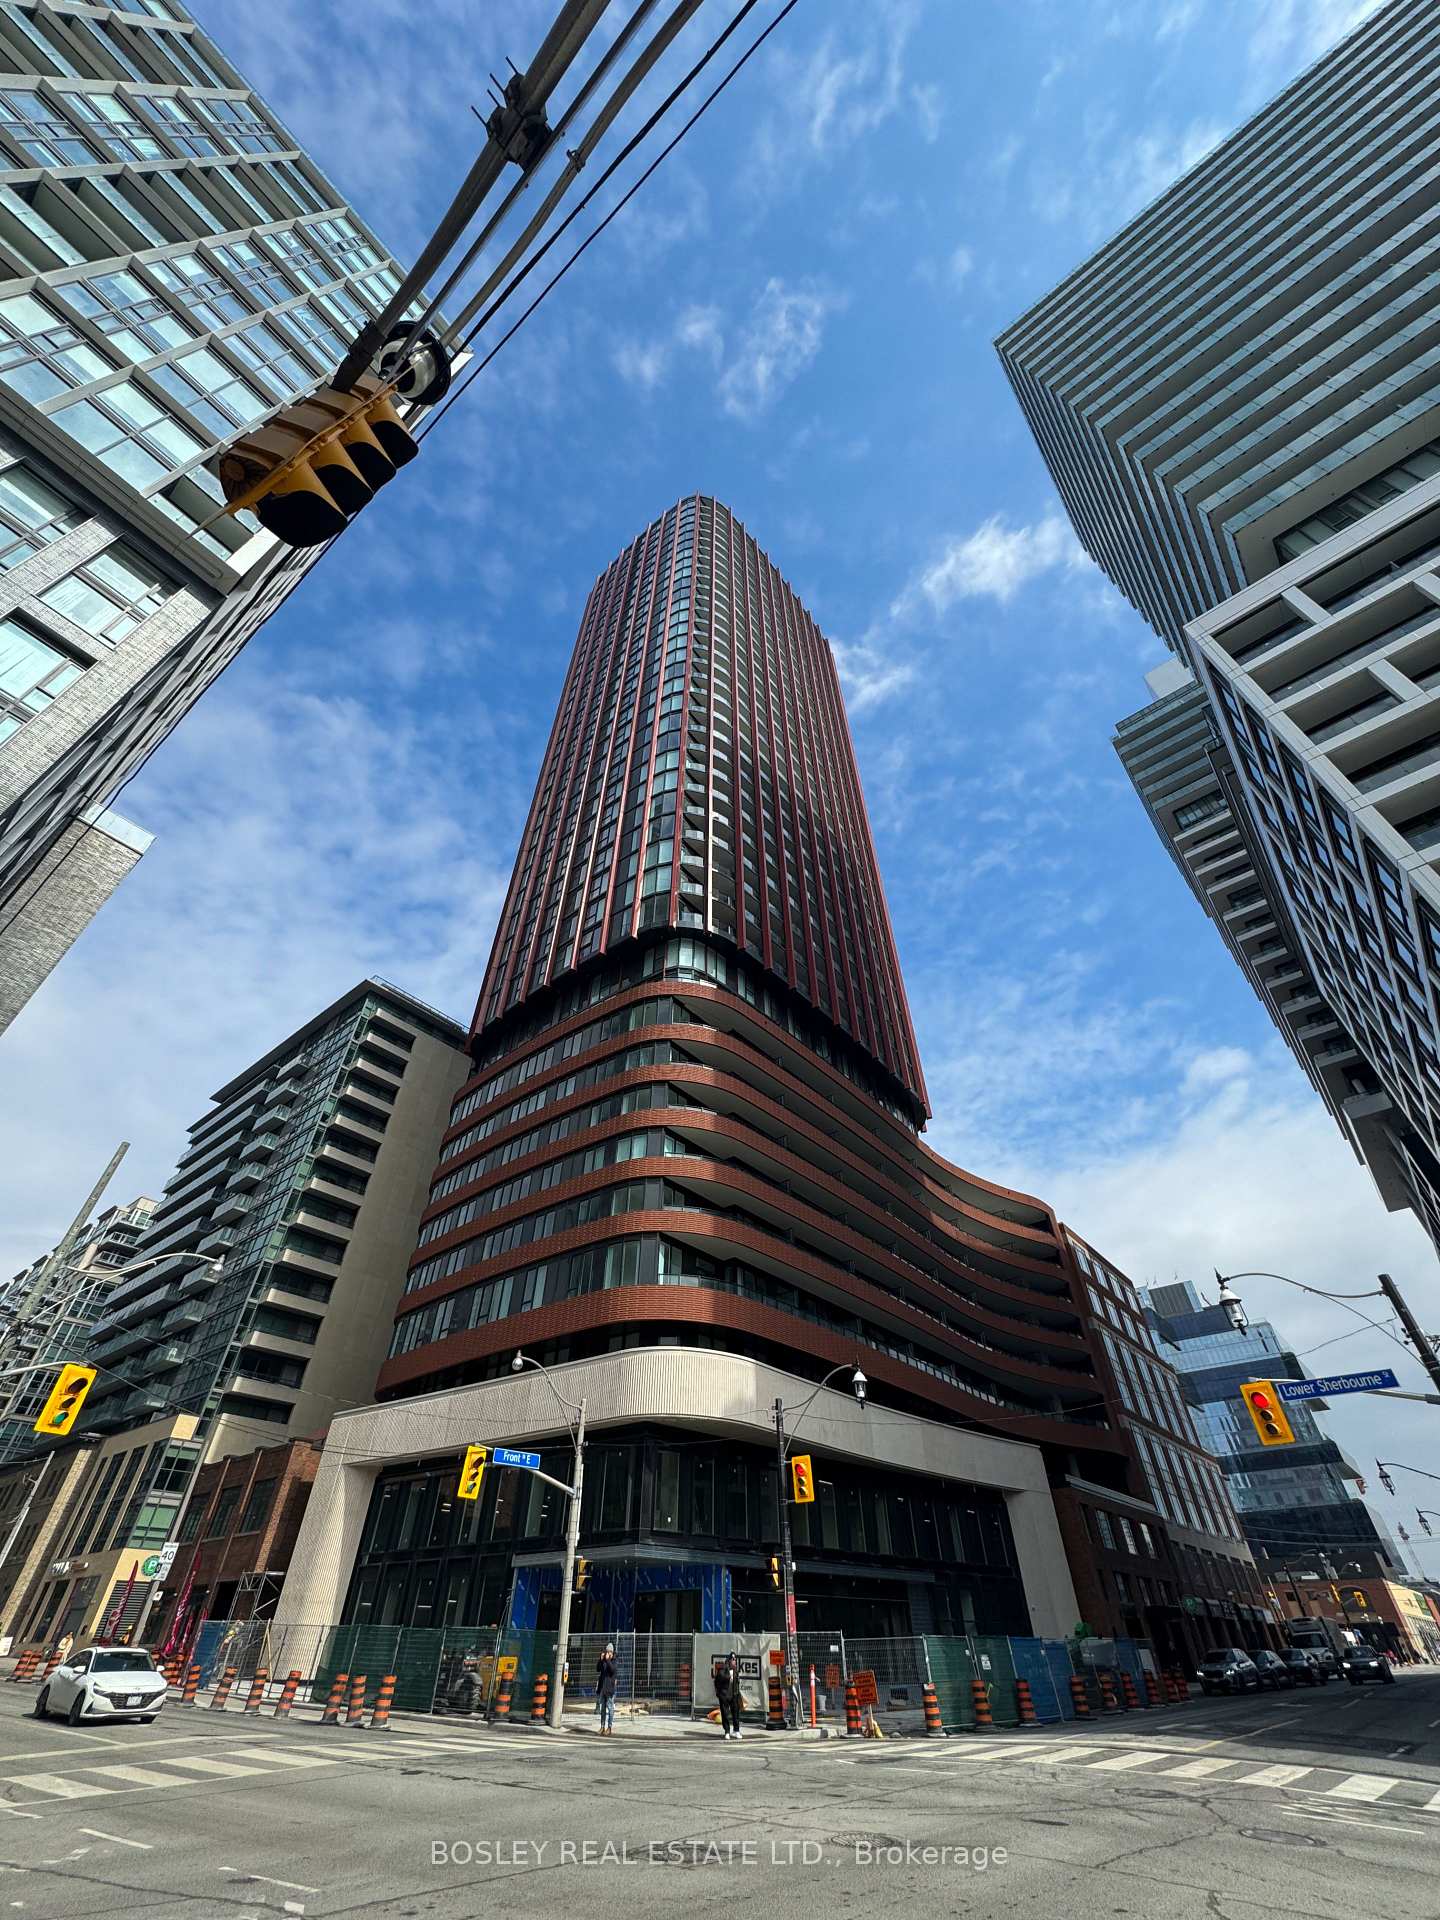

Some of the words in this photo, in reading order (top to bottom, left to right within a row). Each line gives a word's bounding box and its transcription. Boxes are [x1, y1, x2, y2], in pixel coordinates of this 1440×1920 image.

[1282, 1383, 1315, 1397] Lower
[1316, 1374, 1382, 1393] Sherbourne
[503, 1451, 521, 1463] Front
[526, 1455, 530, 1464] E
[162, 1551, 175, 1560] 40
